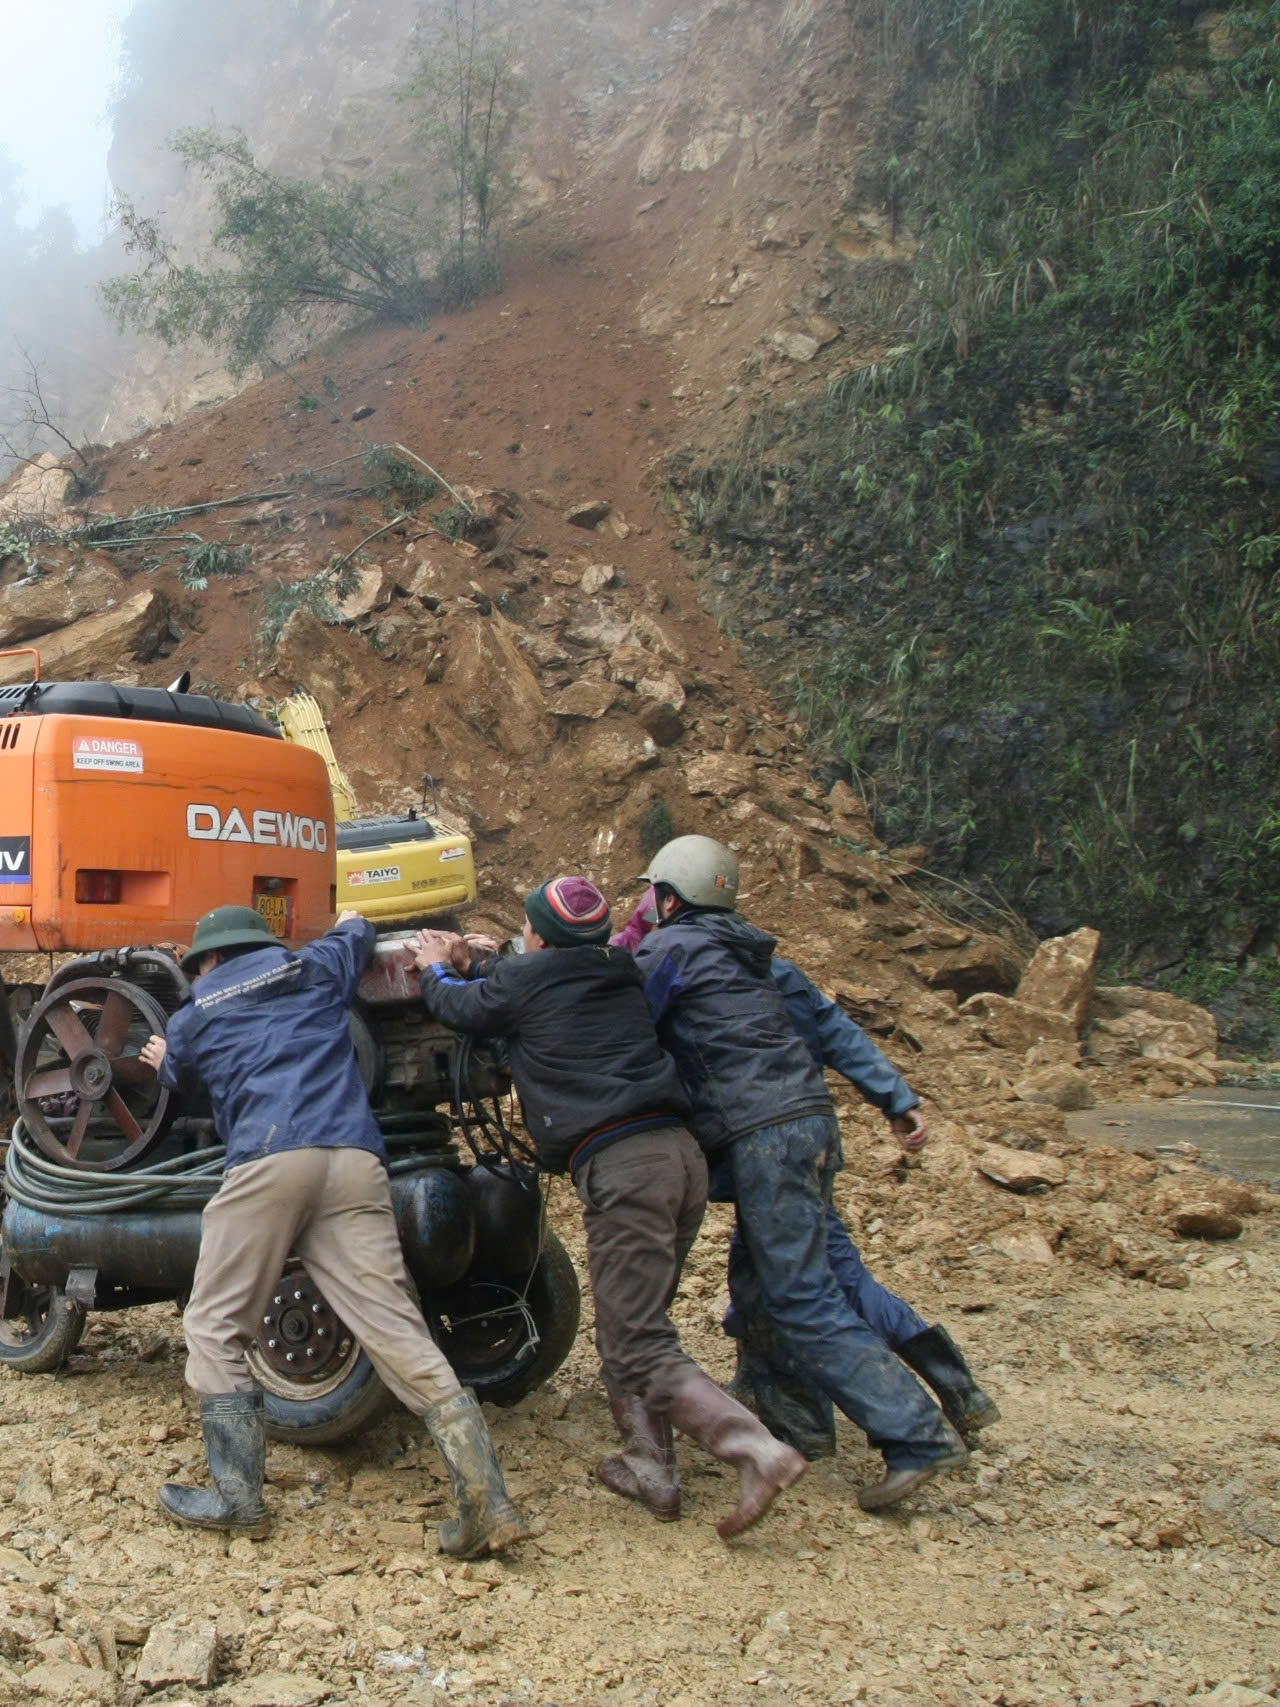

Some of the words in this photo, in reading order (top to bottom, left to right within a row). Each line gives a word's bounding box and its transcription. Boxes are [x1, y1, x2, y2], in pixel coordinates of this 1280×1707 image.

[91, 740, 137, 755] DANGER
[76, 757, 93, 765] KEEP
[94, 758, 105, 766] OFF
[105, 759, 124, 767] SWING
[125, 760, 141, 769] AREA
[186, 803, 328, 854] DAEWOO
[366, 867, 399, 879] TAIYO
